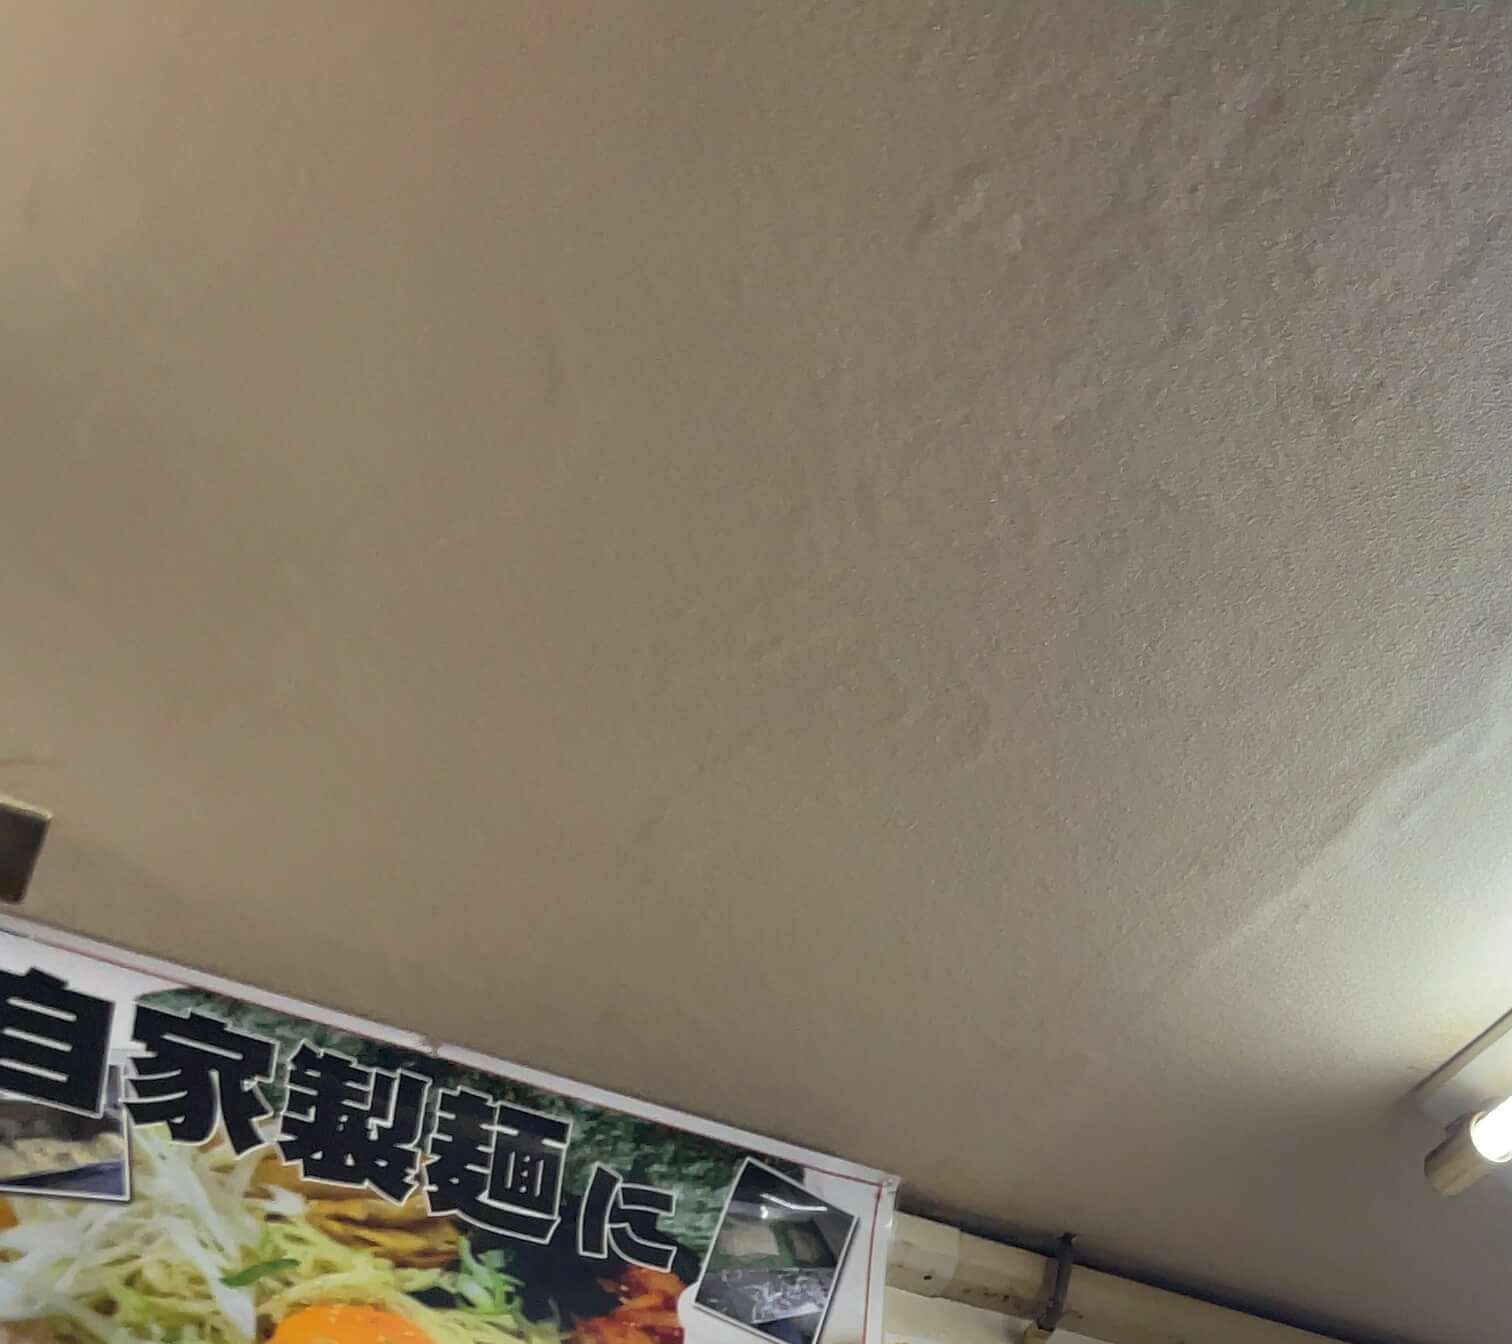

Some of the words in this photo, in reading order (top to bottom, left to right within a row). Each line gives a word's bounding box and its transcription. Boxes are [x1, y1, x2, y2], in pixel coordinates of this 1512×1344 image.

[0, 968, 678, 1270] 自家製麺に
